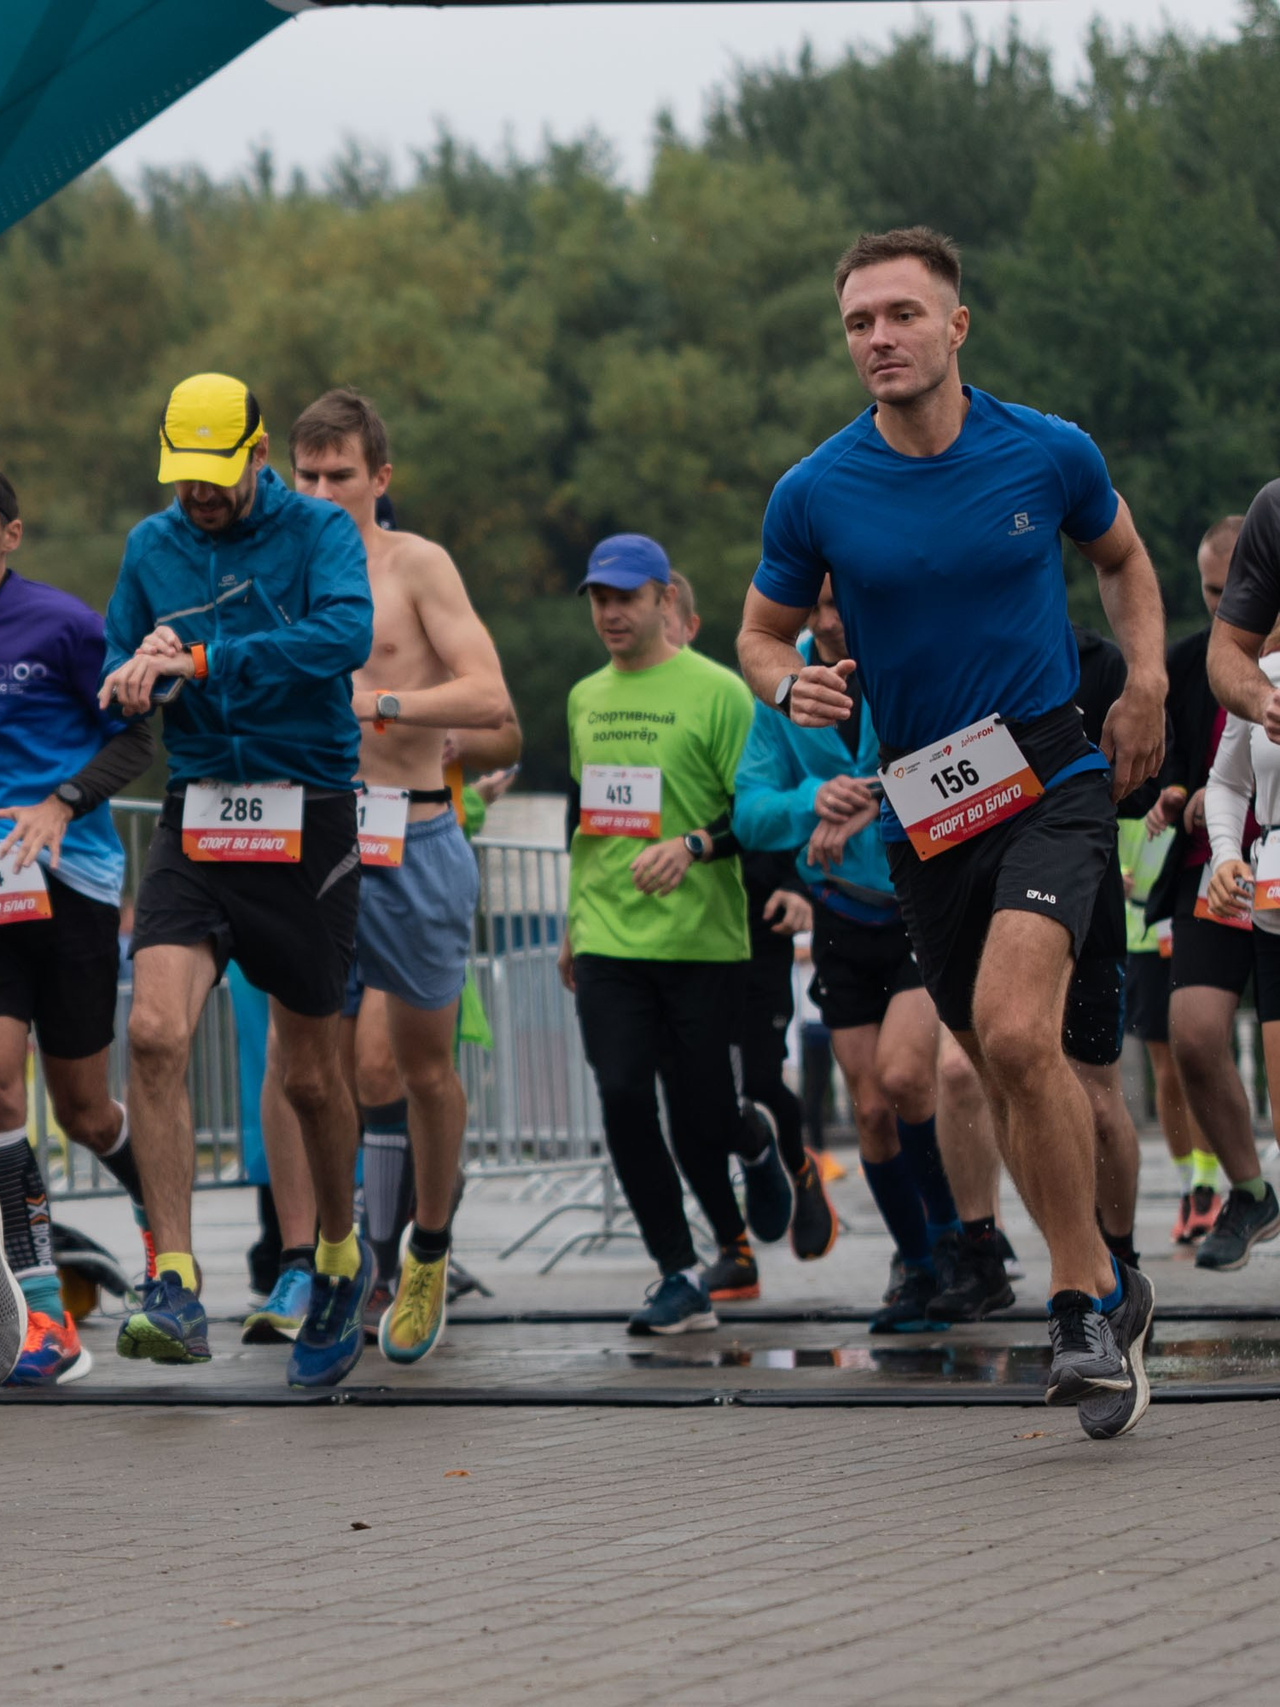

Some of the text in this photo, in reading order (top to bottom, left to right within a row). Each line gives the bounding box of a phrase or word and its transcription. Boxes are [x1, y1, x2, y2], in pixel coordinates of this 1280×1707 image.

[588, 711, 676, 725] Спортивный
[592, 727, 658, 744] волонтёр
[930, 759, 980, 799] 156
[606, 784, 632, 805] 413
[220, 797, 263, 822] 286
[929, 812, 965, 841] СПОРТ
[967, 803, 984, 823] ВО
[985, 784, 1022, 814] БЛАГО
[197, 836, 286, 851] СПОРТ ВО БЛАГО
[3, 898, 36, 913] БЛАГО
